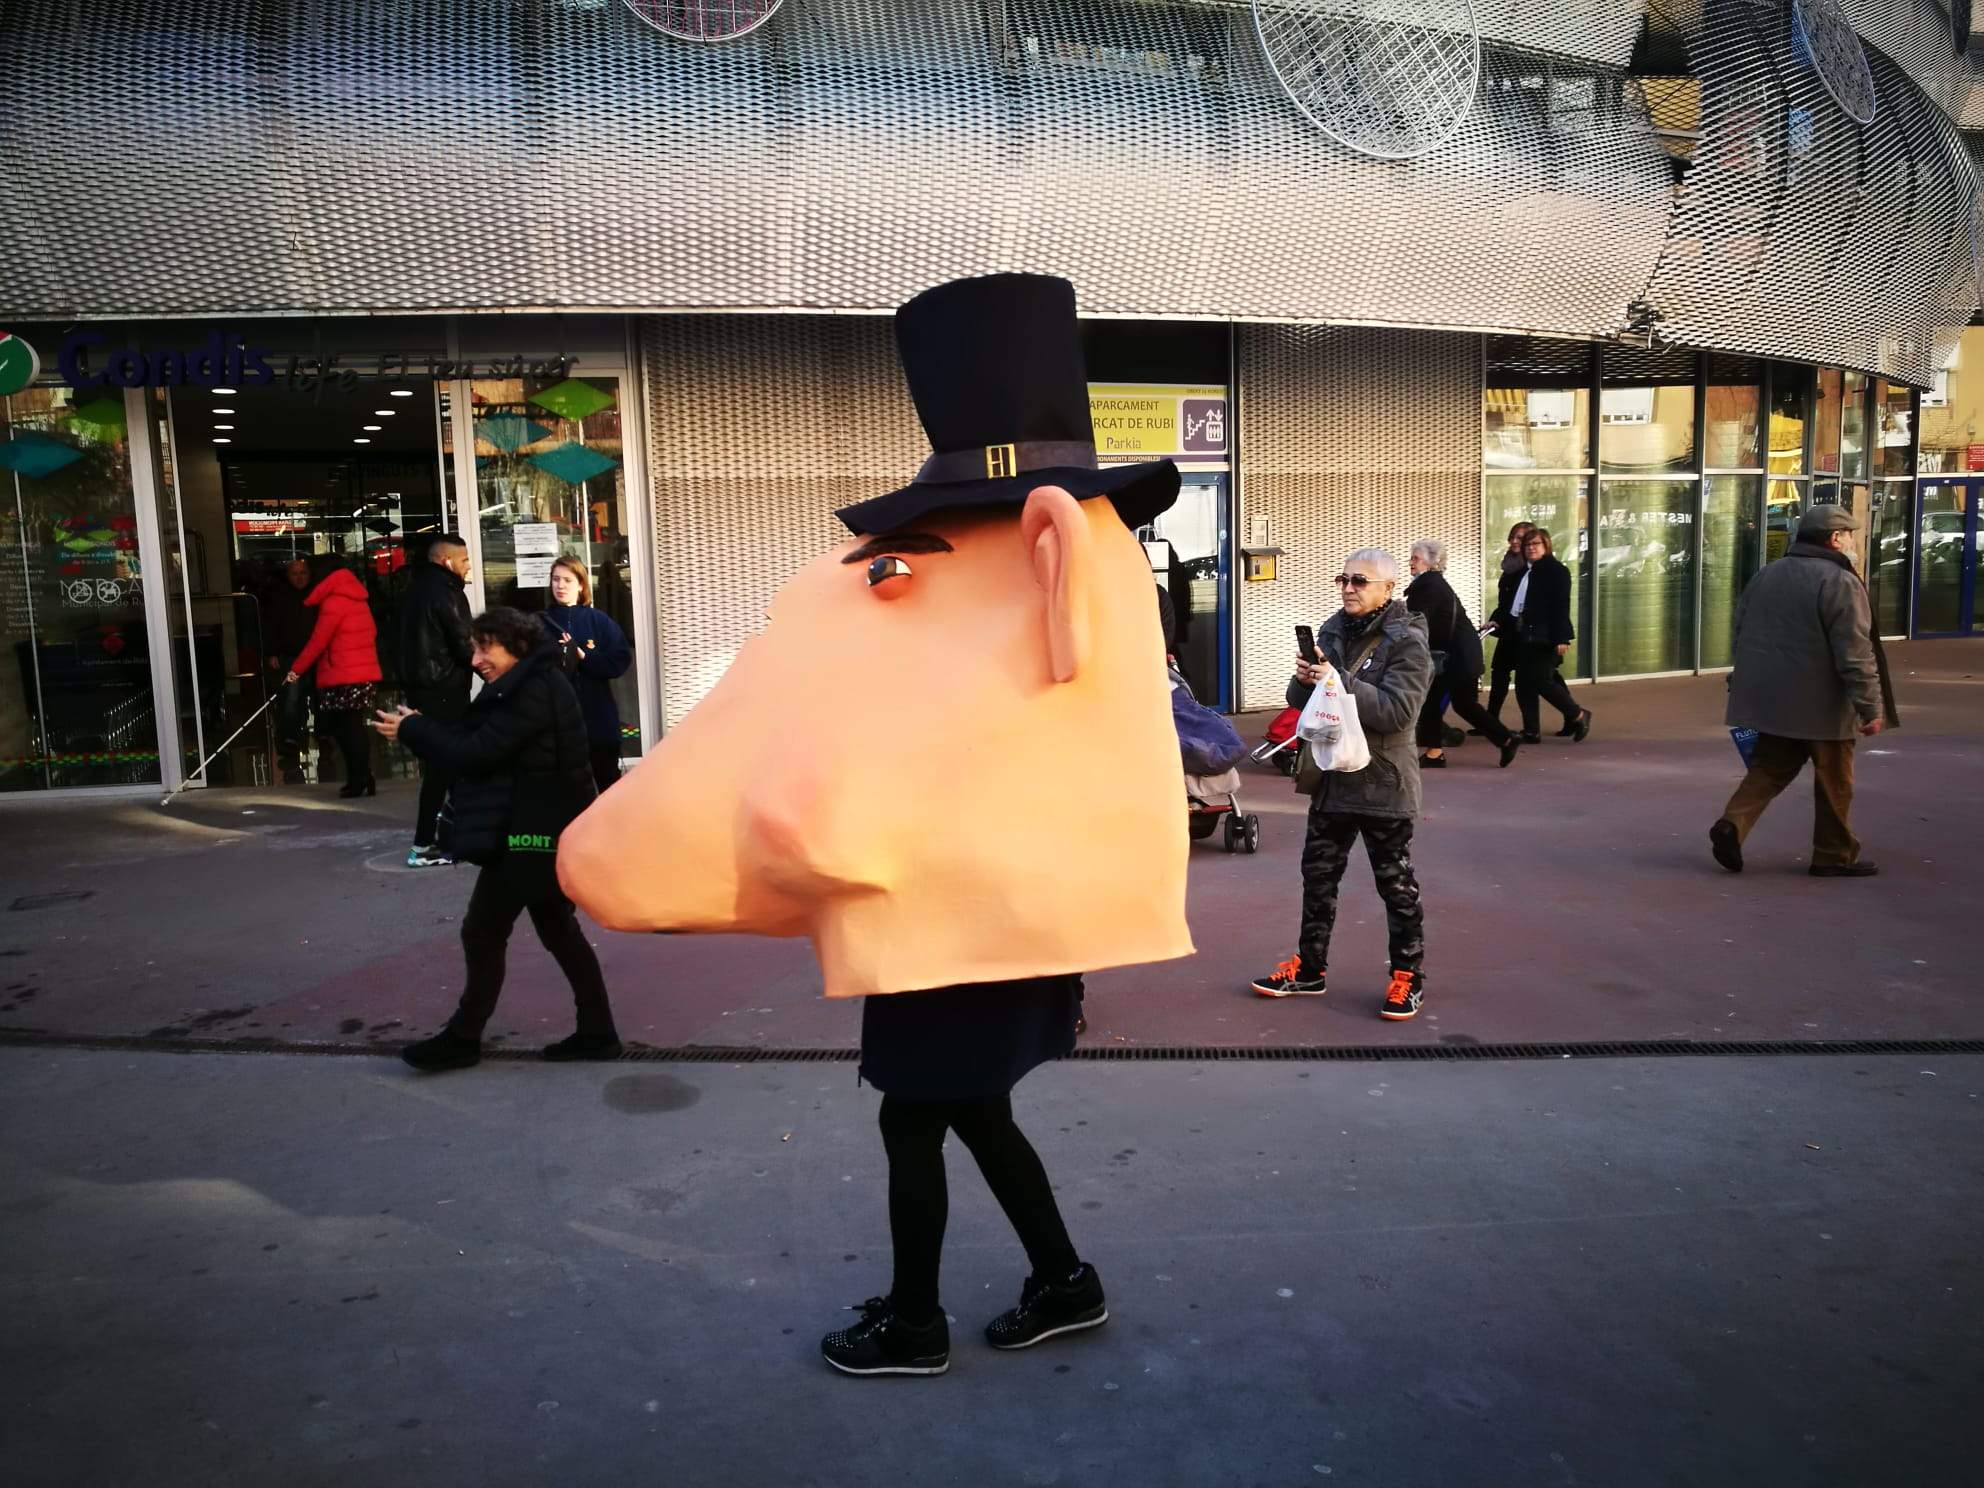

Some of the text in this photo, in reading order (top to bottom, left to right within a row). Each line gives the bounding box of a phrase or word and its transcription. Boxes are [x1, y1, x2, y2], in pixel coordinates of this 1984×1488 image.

[58, 329, 273, 387] Condis
[1089, 400, 1160, 411] APARCAMENT
[1093, 417, 1125, 429] RCAT
[1128, 417, 1144, 429] DE
[1106, 437, 1142, 450] Parkia
[508, 834, 552, 848] MONT
